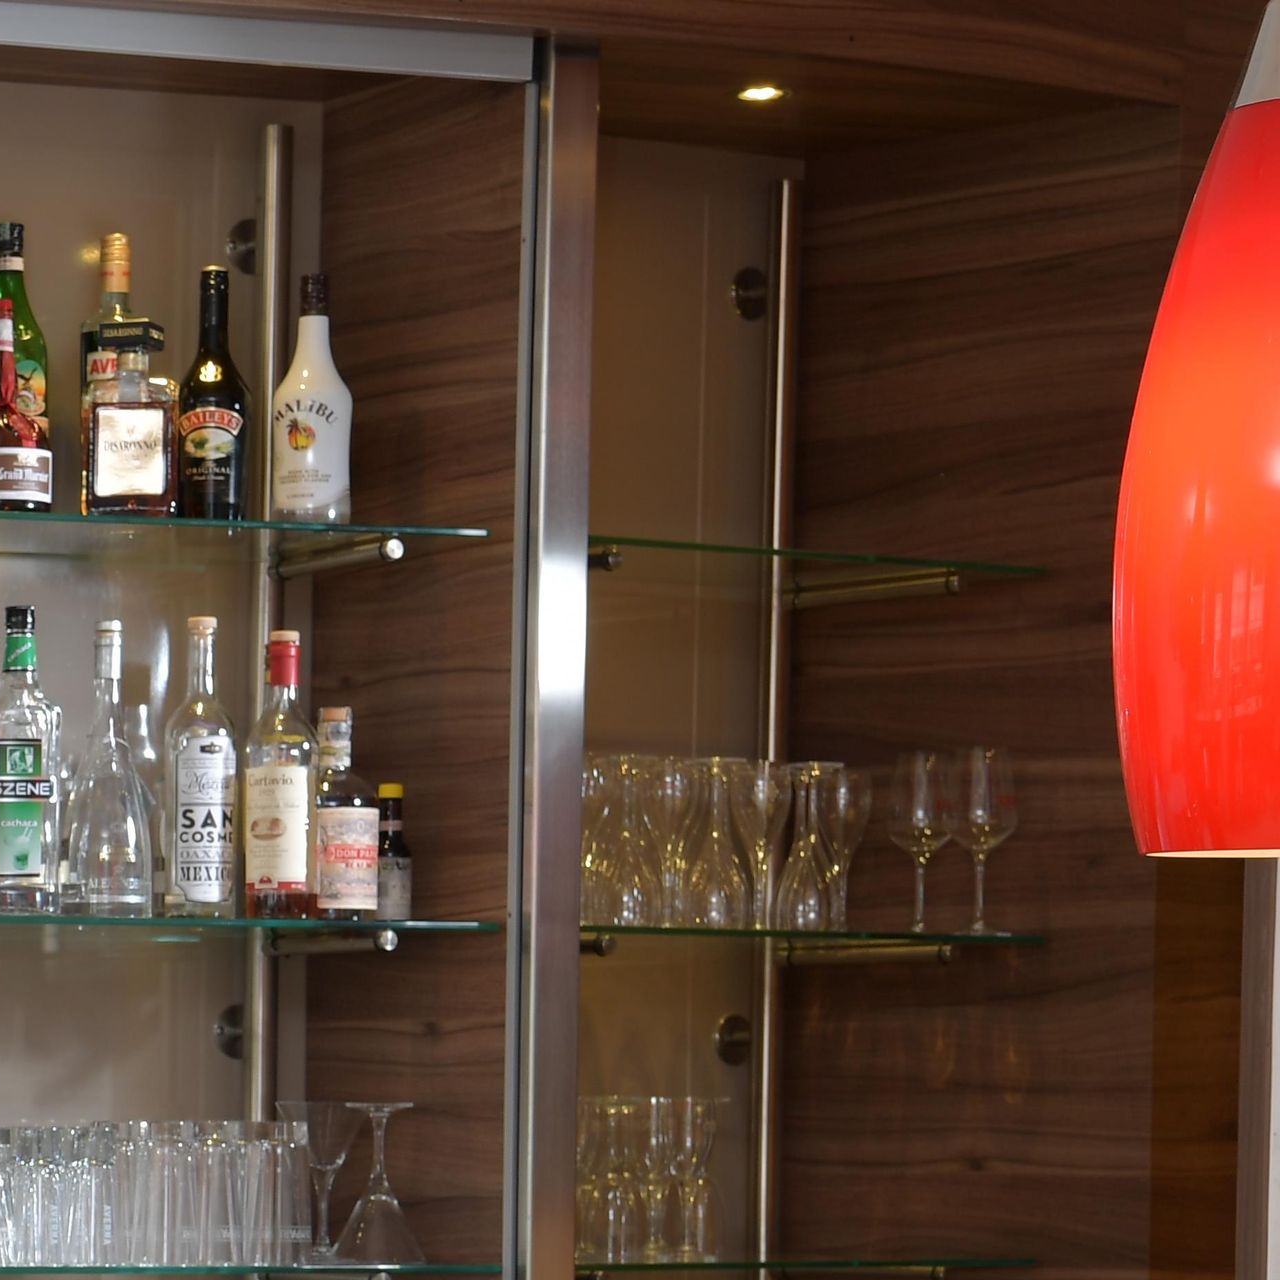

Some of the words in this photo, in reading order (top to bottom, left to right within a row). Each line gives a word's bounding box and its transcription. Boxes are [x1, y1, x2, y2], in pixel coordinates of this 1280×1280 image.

[182, 409, 239, 432] BAILEYS
[104, 440, 157, 452] DISARONNO
[181, 809, 233, 829] SAN
[180, 850, 230, 860] OAXAC
[336, 848, 357, 858] DON
